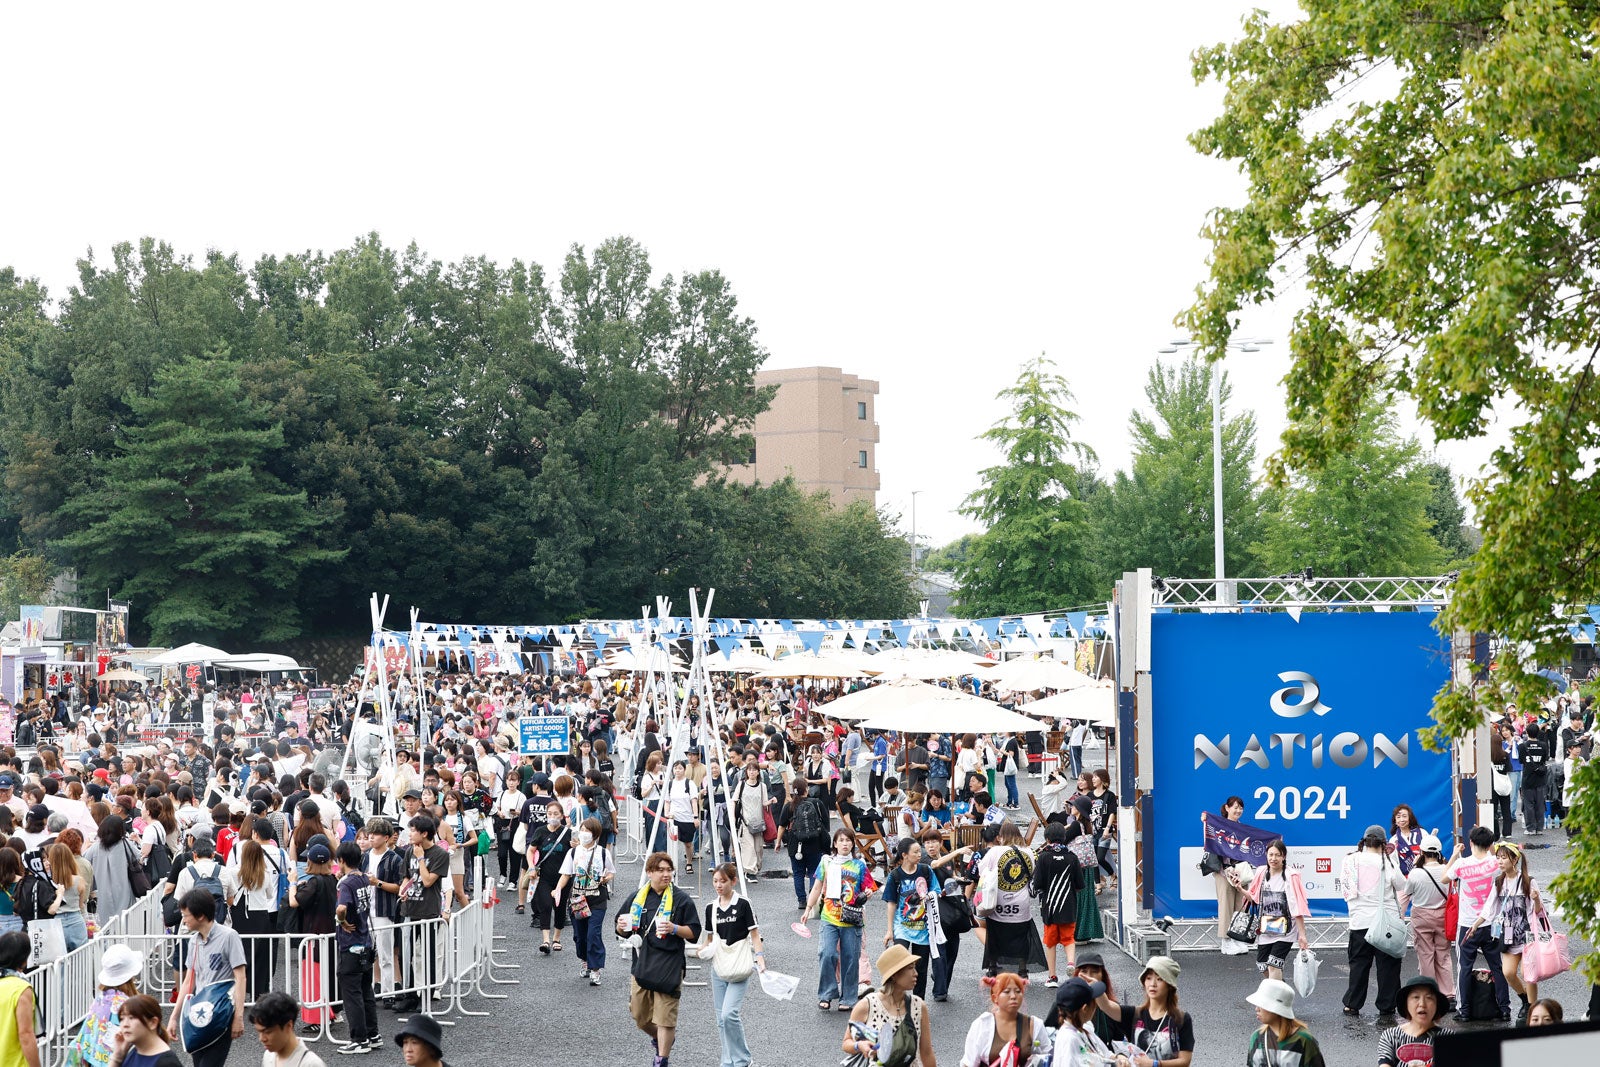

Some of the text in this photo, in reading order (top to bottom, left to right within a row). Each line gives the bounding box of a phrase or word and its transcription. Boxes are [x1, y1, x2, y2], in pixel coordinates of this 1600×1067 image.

[1269, 671, 1332, 718] a
[1193, 732, 1409, 771] NATION
[1253, 786, 1351, 821] 2024
